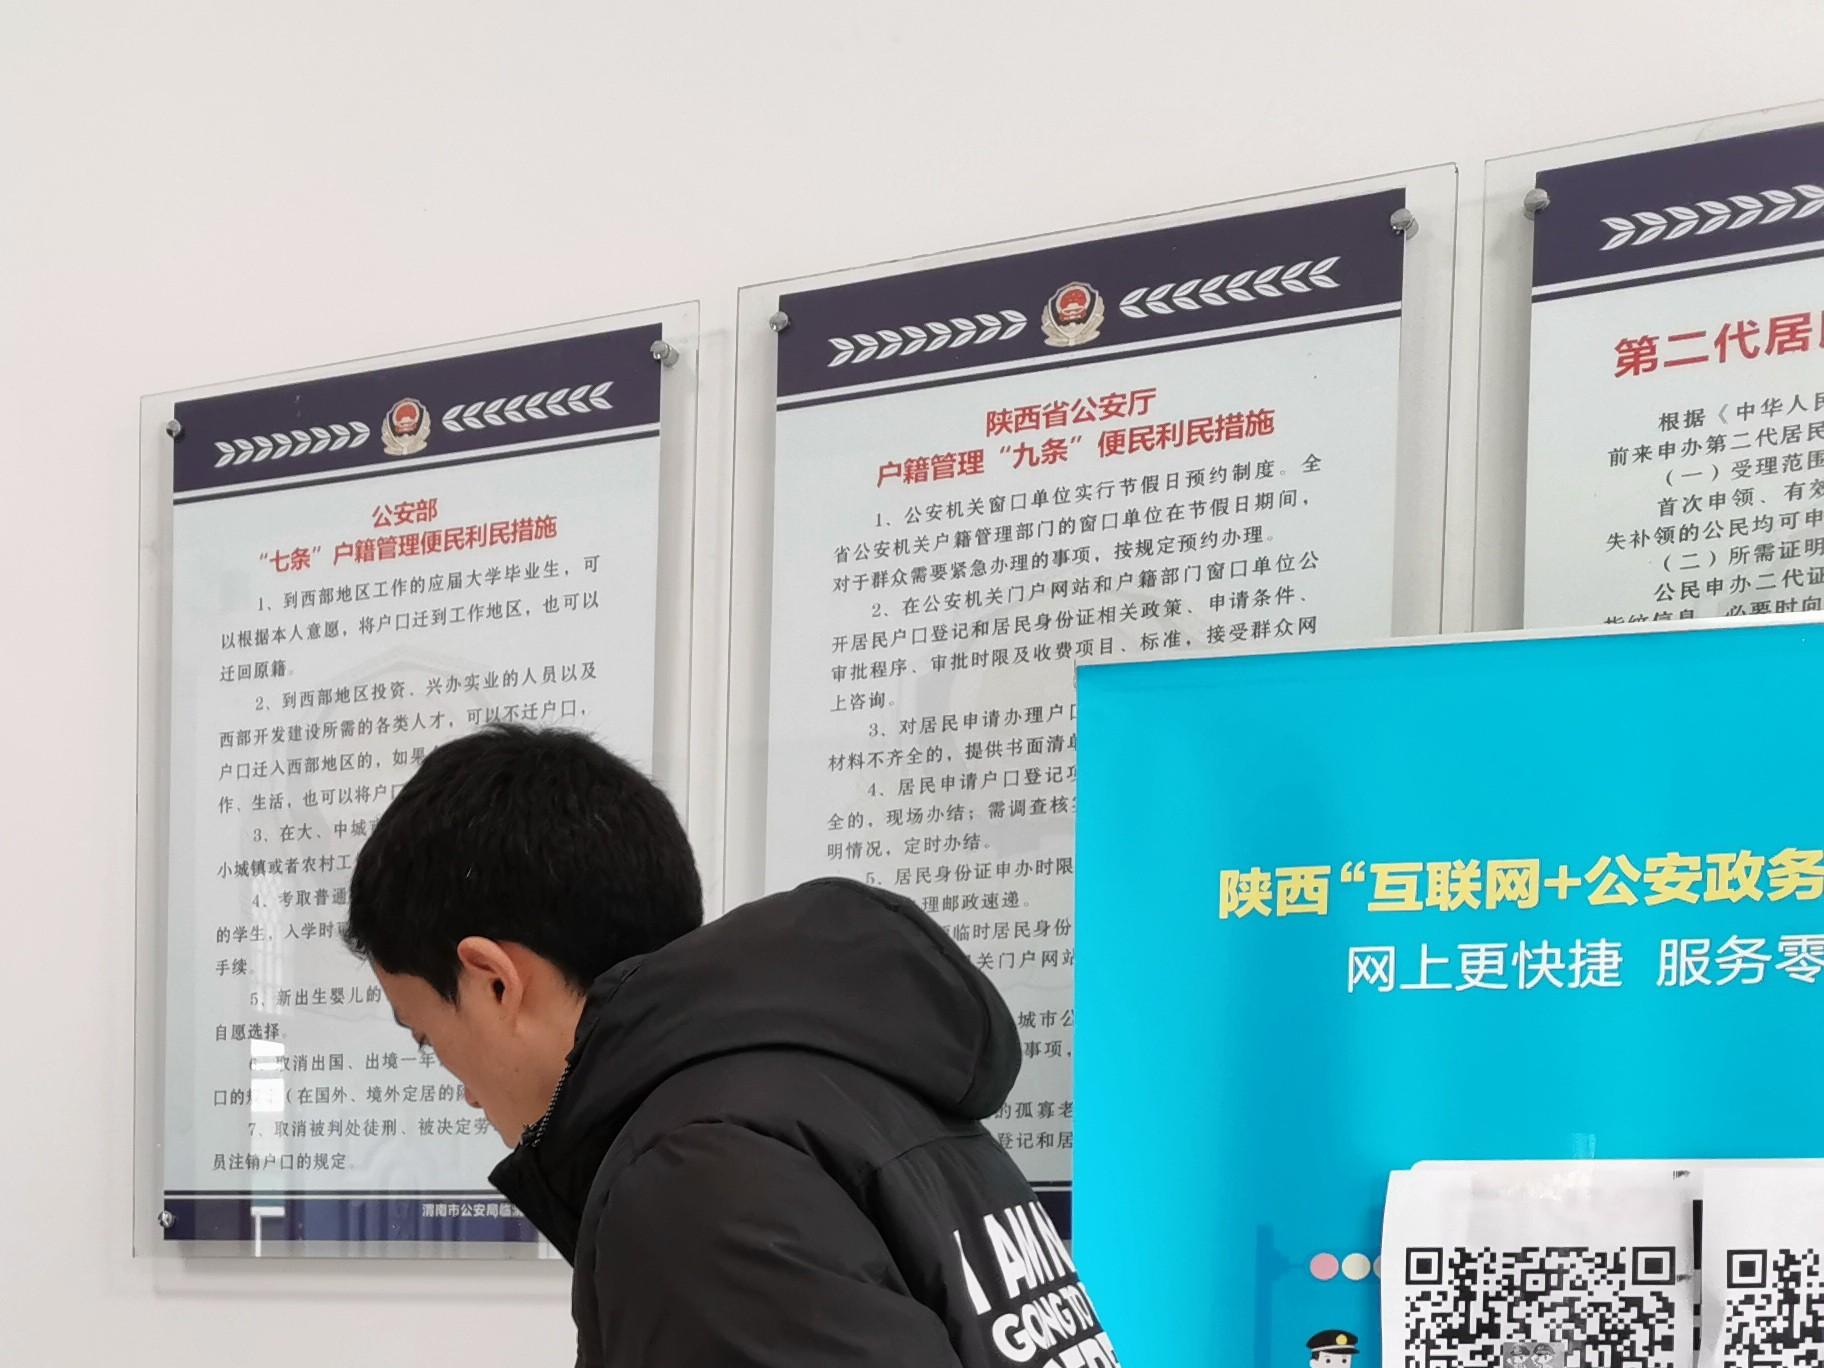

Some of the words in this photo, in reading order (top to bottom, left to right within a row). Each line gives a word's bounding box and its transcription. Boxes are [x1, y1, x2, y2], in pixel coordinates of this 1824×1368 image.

[1614, 311, 1824, 378] 第二代居
[986, 388, 1156, 436] 陕西省公安厅
[371, 498, 438, 528] 公安部
[218, 745, 440, 782] 户口迁入西部地区的，如果
[827, 795, 1076, 831] 全的，现场办结；需调查核
[967, 948, 1074, 970] 关门户网站
[1347, 937, 1623, 993] 网上更快捷
[1656, 933, 1824, 988] 服务零
[248, 1117, 496, 1139] 7、取消被判处徒刑、被决定劳
